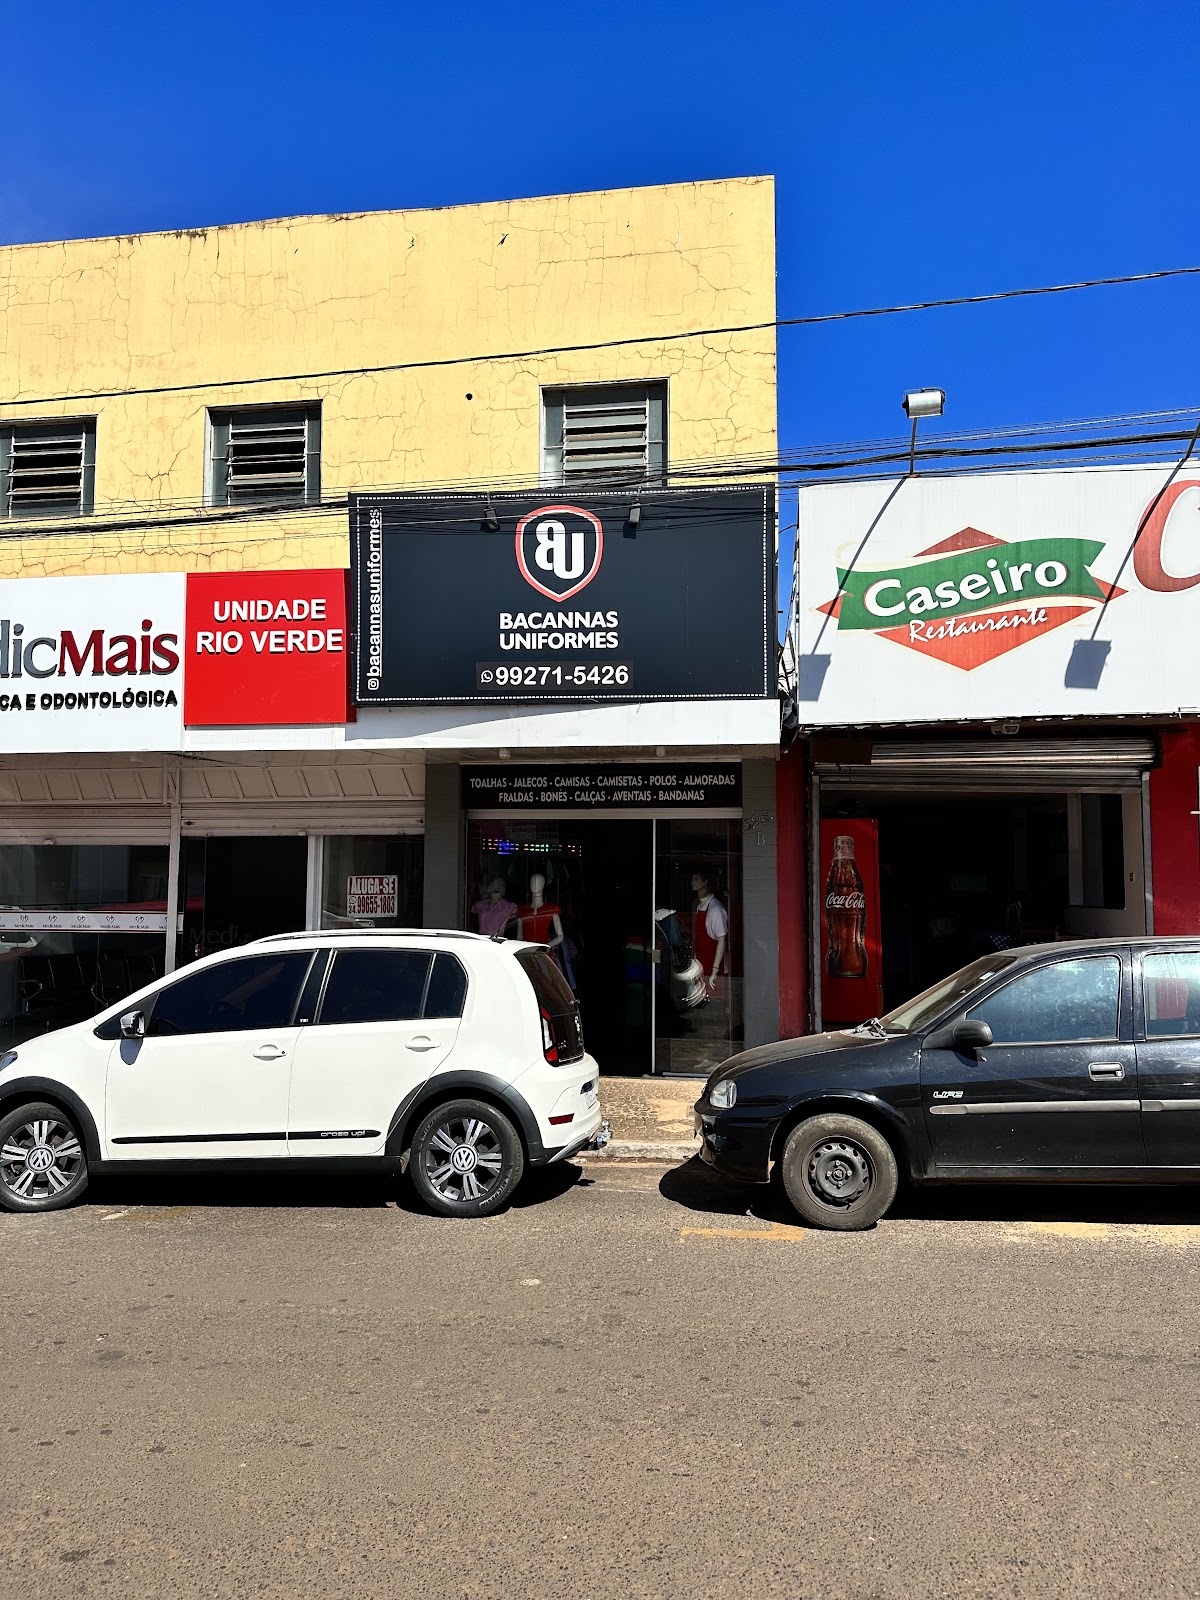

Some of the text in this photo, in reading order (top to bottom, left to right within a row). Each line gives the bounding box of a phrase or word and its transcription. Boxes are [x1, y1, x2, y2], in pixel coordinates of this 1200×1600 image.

[366, 508, 382, 677] bacannasuniformes
[864, 558, 1068, 617] Caseiro
[213, 598, 327, 622] UNIDADE
[499, 611, 619, 630] BACANNAS
[908, 607, 1048, 644] Restaurante
[0, 619, 180, 679] icMais
[196, 628, 344, 655] RIO VERDE
[499, 631, 619, 650] UNIFORMES
[495, 664, 629, 686] 99271-5426
[26, 693, 36, 711] E
[40, 687, 178, 710] ODONTOLÓGICA
[470, 778, 507, 788] TOALHAS
[513, 777, 548, 788] JALECOS
[554, 776, 590, 787] CAMISAS
[597, 775, 643, 787] CAMISETAS
[649, 775, 677, 786] POLOS
[683, 774, 736, 786] ALMOFADAS
[498, 791, 534, 803] FRALDAS
[540, 789, 568, 802] BONÉS
[574, 790, 606, 804] CALÇAS
[612, 790, 651, 801] AVENTAIS
[658, 789, 705, 801] BANDANAS
[350, 877, 394, 895] ALUGA-SE
[357, 895, 395, 914] 99655-1803
[826, 891, 865, 909] Coca-Cola
